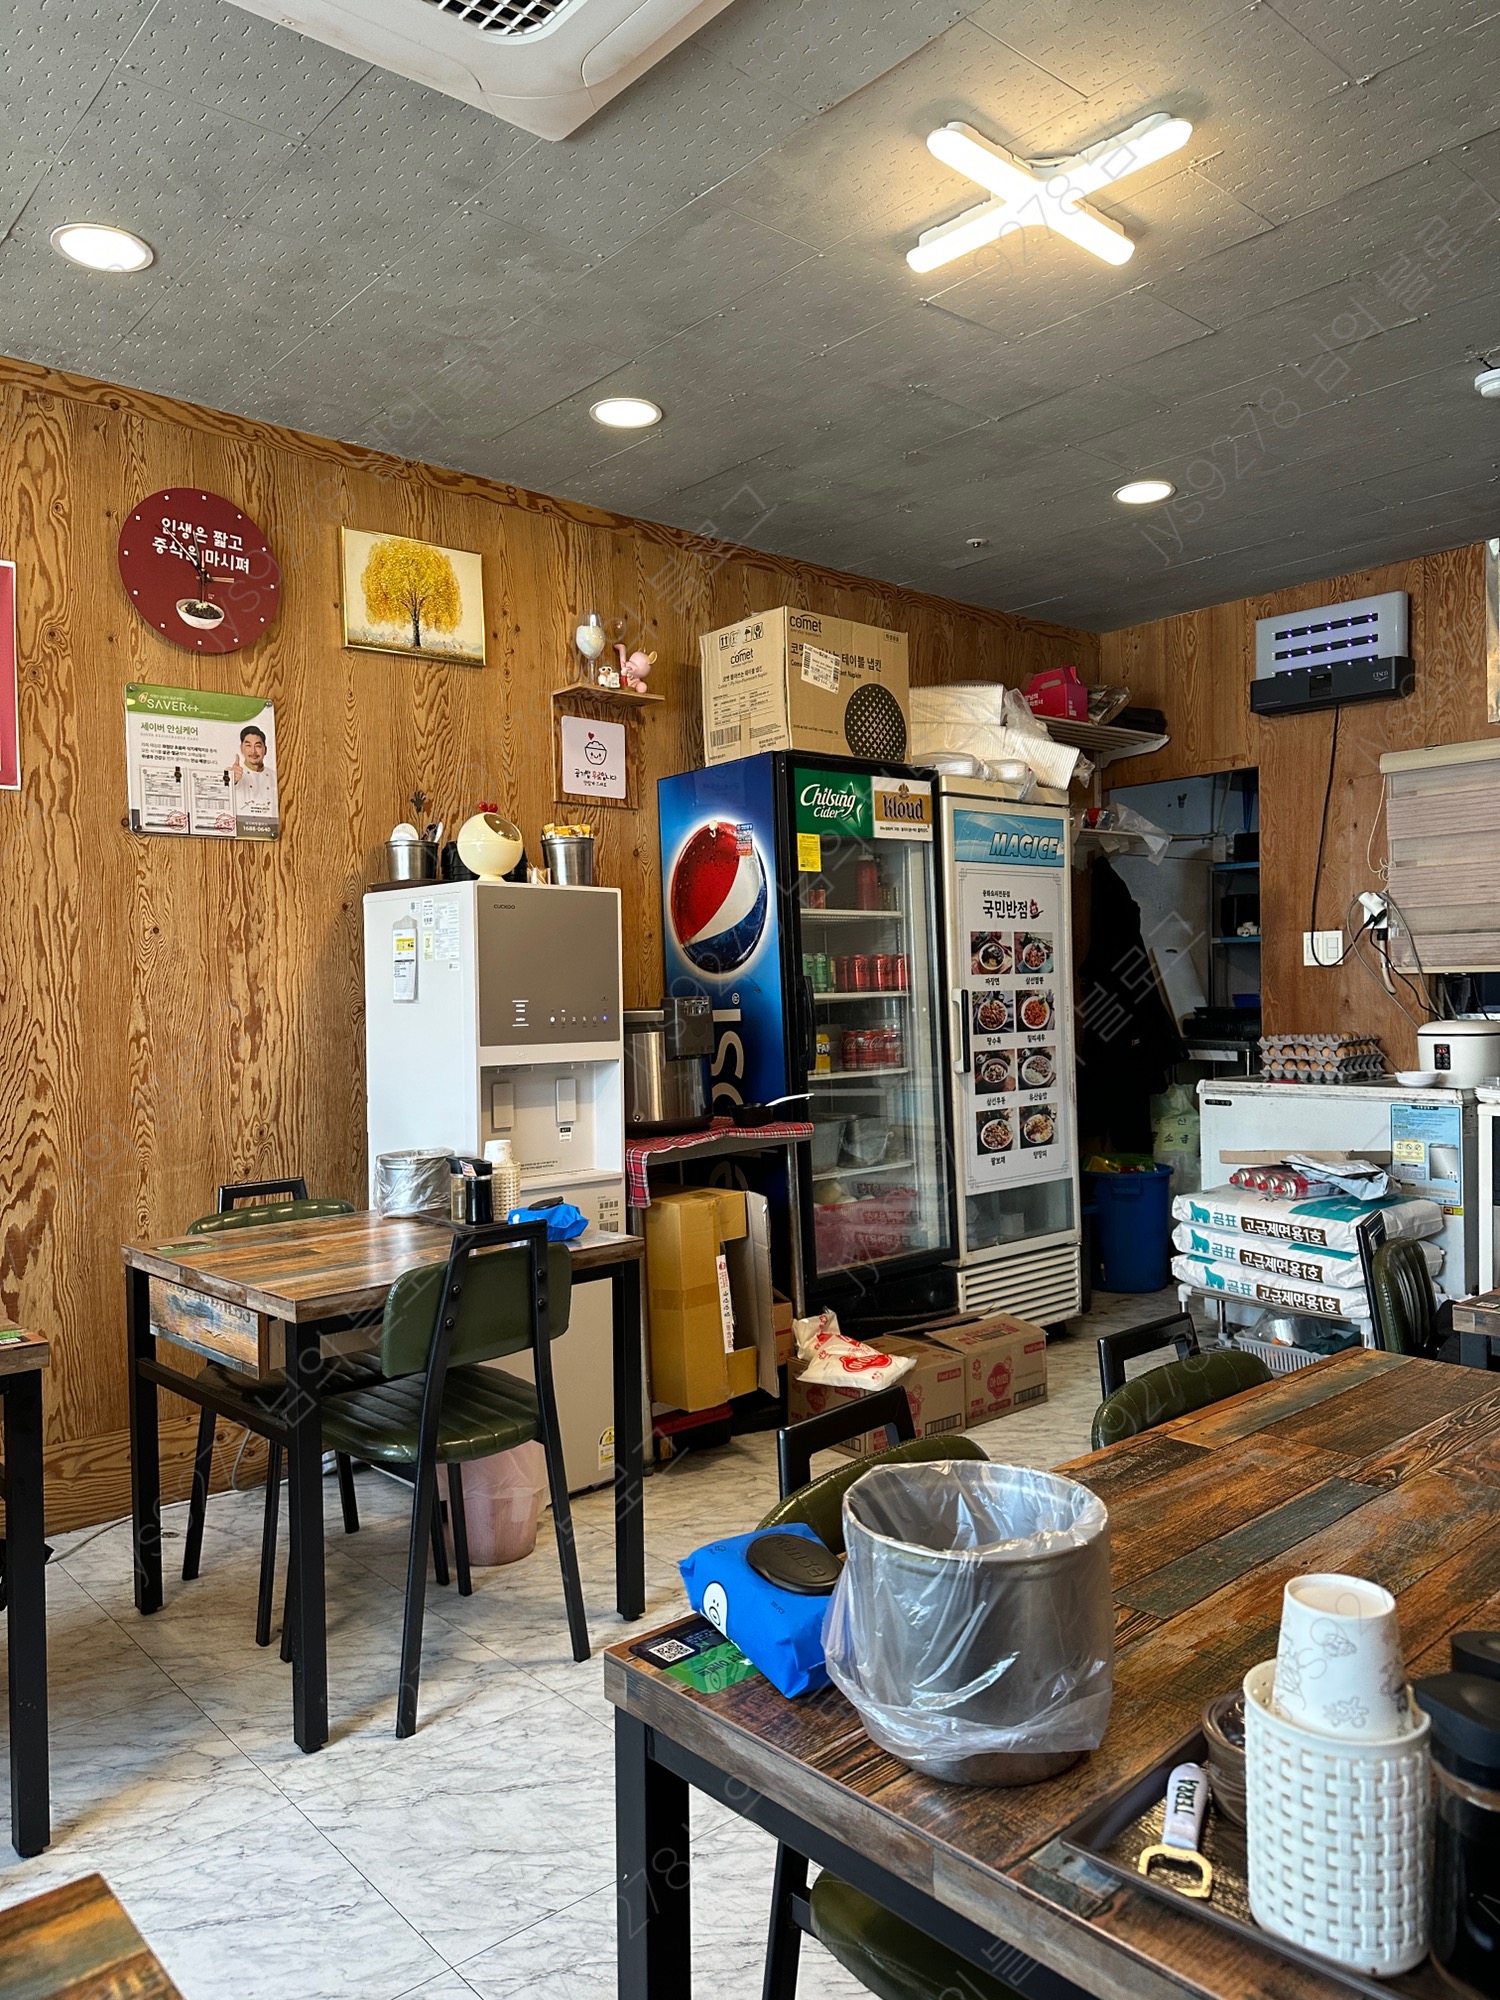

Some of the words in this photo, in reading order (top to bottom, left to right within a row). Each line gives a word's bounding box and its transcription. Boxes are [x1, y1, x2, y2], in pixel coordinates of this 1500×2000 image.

[212, 530, 244, 552] 짧고
[789, 614, 822, 633] comet
[731, 647, 754, 664] comet
[841, 653, 865, 669] 테이블
[867, 658, 882, 672] 냅킨
[141, 722, 165, 732] 세이버
[166, 724, 199, 736] 안심케어
[813, 806, 845, 819] Cider
[883, 794, 925, 821] Kloud
[989, 832, 1058, 861] MAGICE
[983, 899, 1028, 919] 국민반점
[1212, 1211, 1238, 1228] 곰표
[1244, 1217, 1325, 1245] 고급제면용1호
[1211, 1241, 1236, 1261] 곰표
[1242, 1251, 1322, 1282] 고급제면용1호
[1226, 1278, 1252, 1296] 곰표
[1259, 1285, 1339, 1314] 고급제면용1호
[1173, 1779, 1200, 1815] TERRA
